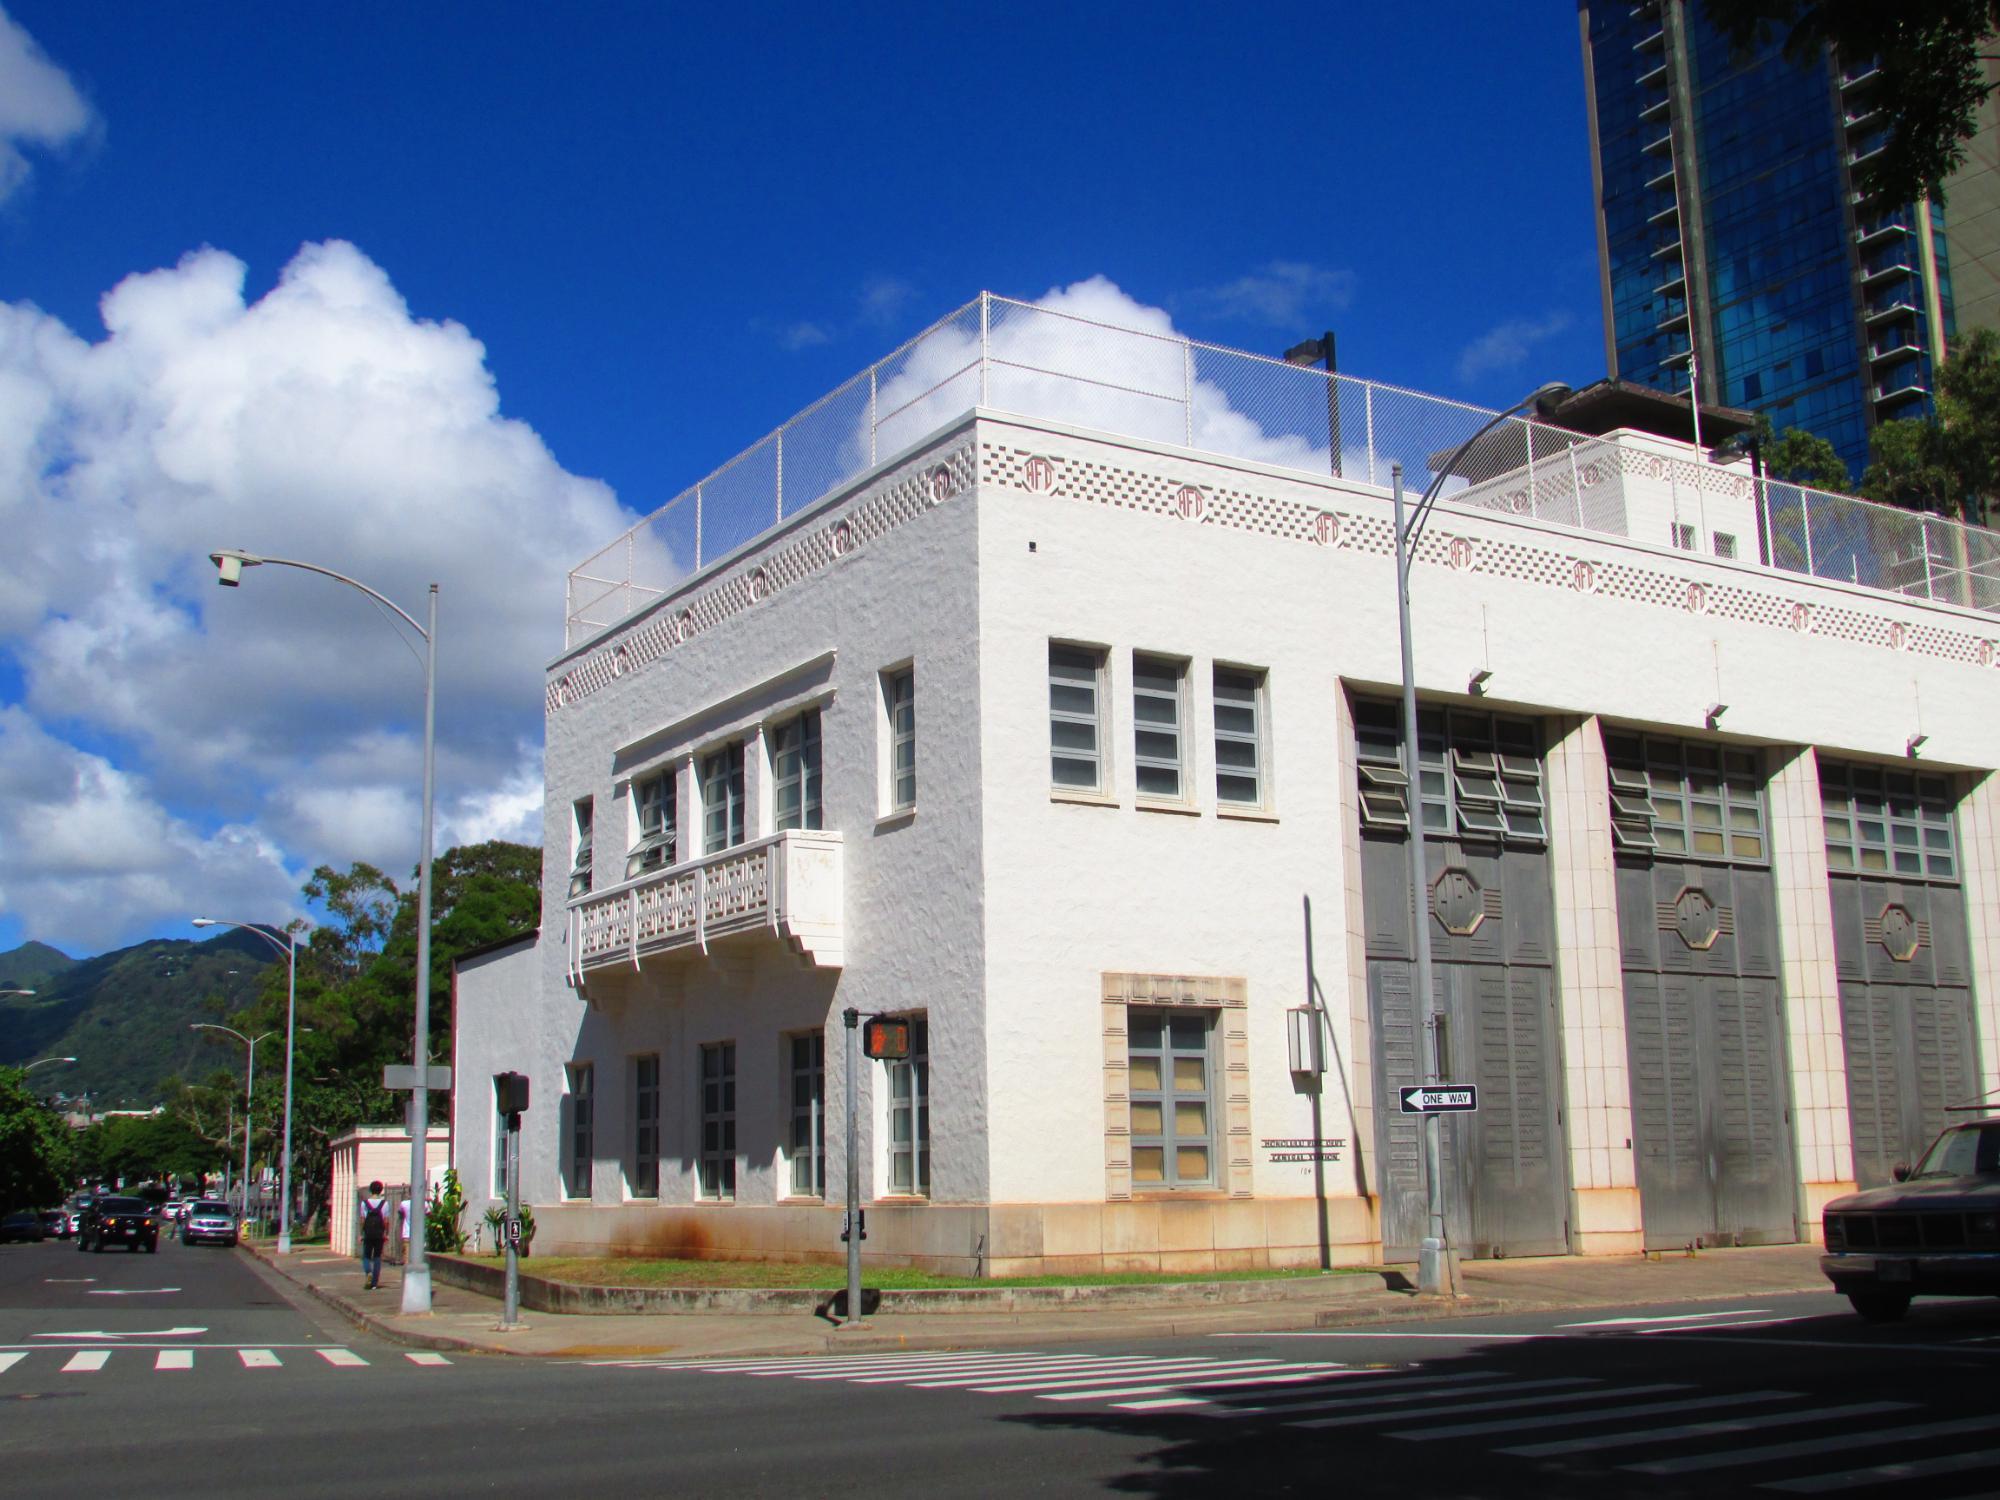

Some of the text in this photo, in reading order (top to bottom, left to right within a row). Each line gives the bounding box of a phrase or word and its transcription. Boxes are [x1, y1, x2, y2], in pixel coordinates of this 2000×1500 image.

[1026, 456, 1052, 490] HFD
[1177, 488, 1202, 518] HFD
[1317, 514, 1338, 543] HFD
[1450, 539, 1471, 567] HFD
[1574, 561, 1594, 590] HFD
[1687, 584, 1704, 610] HFD
[1792, 604, 1808, 630] HFD
[1890, 622, 1905, 648] HFD
[1423, 1093, 1468, 1104] ONE WAY
